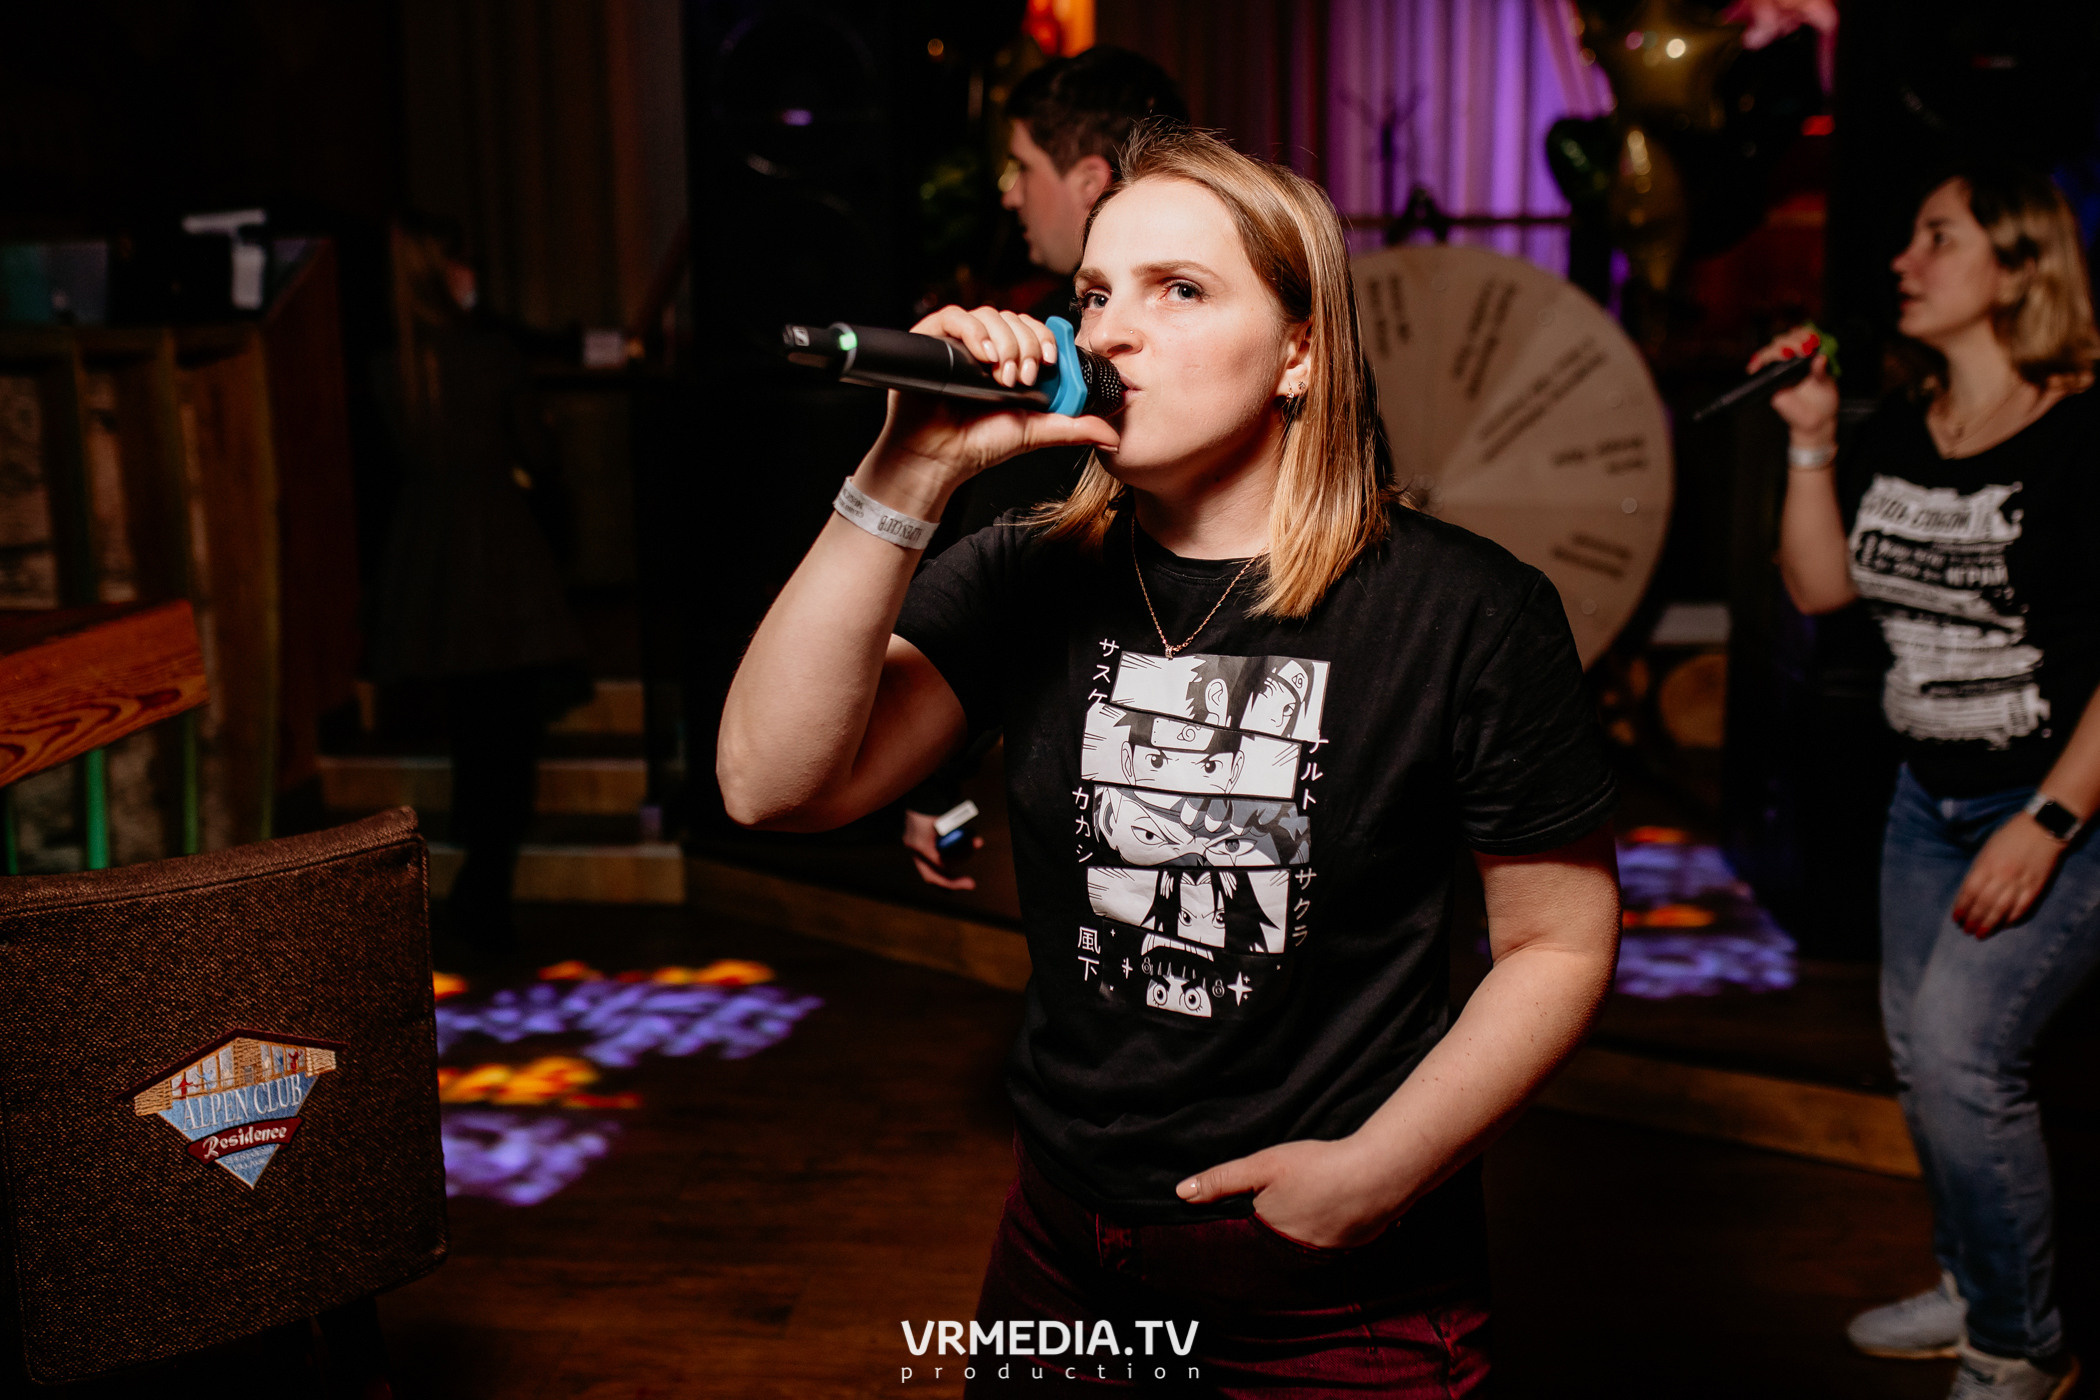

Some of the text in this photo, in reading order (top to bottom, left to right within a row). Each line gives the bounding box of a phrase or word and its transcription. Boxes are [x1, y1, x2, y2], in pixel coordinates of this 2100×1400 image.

[1088, 638, 1120, 706] サスケ
[1301, 728, 1329, 810] ナルト
[1071, 787, 1094, 864] カカシ
[1291, 867, 1318, 947] サクラ
[1077, 926, 1101, 982] 風下
[183, 1074, 303, 1132] ALPEN CLUB
[202, 1125, 287, 1160] Residence
